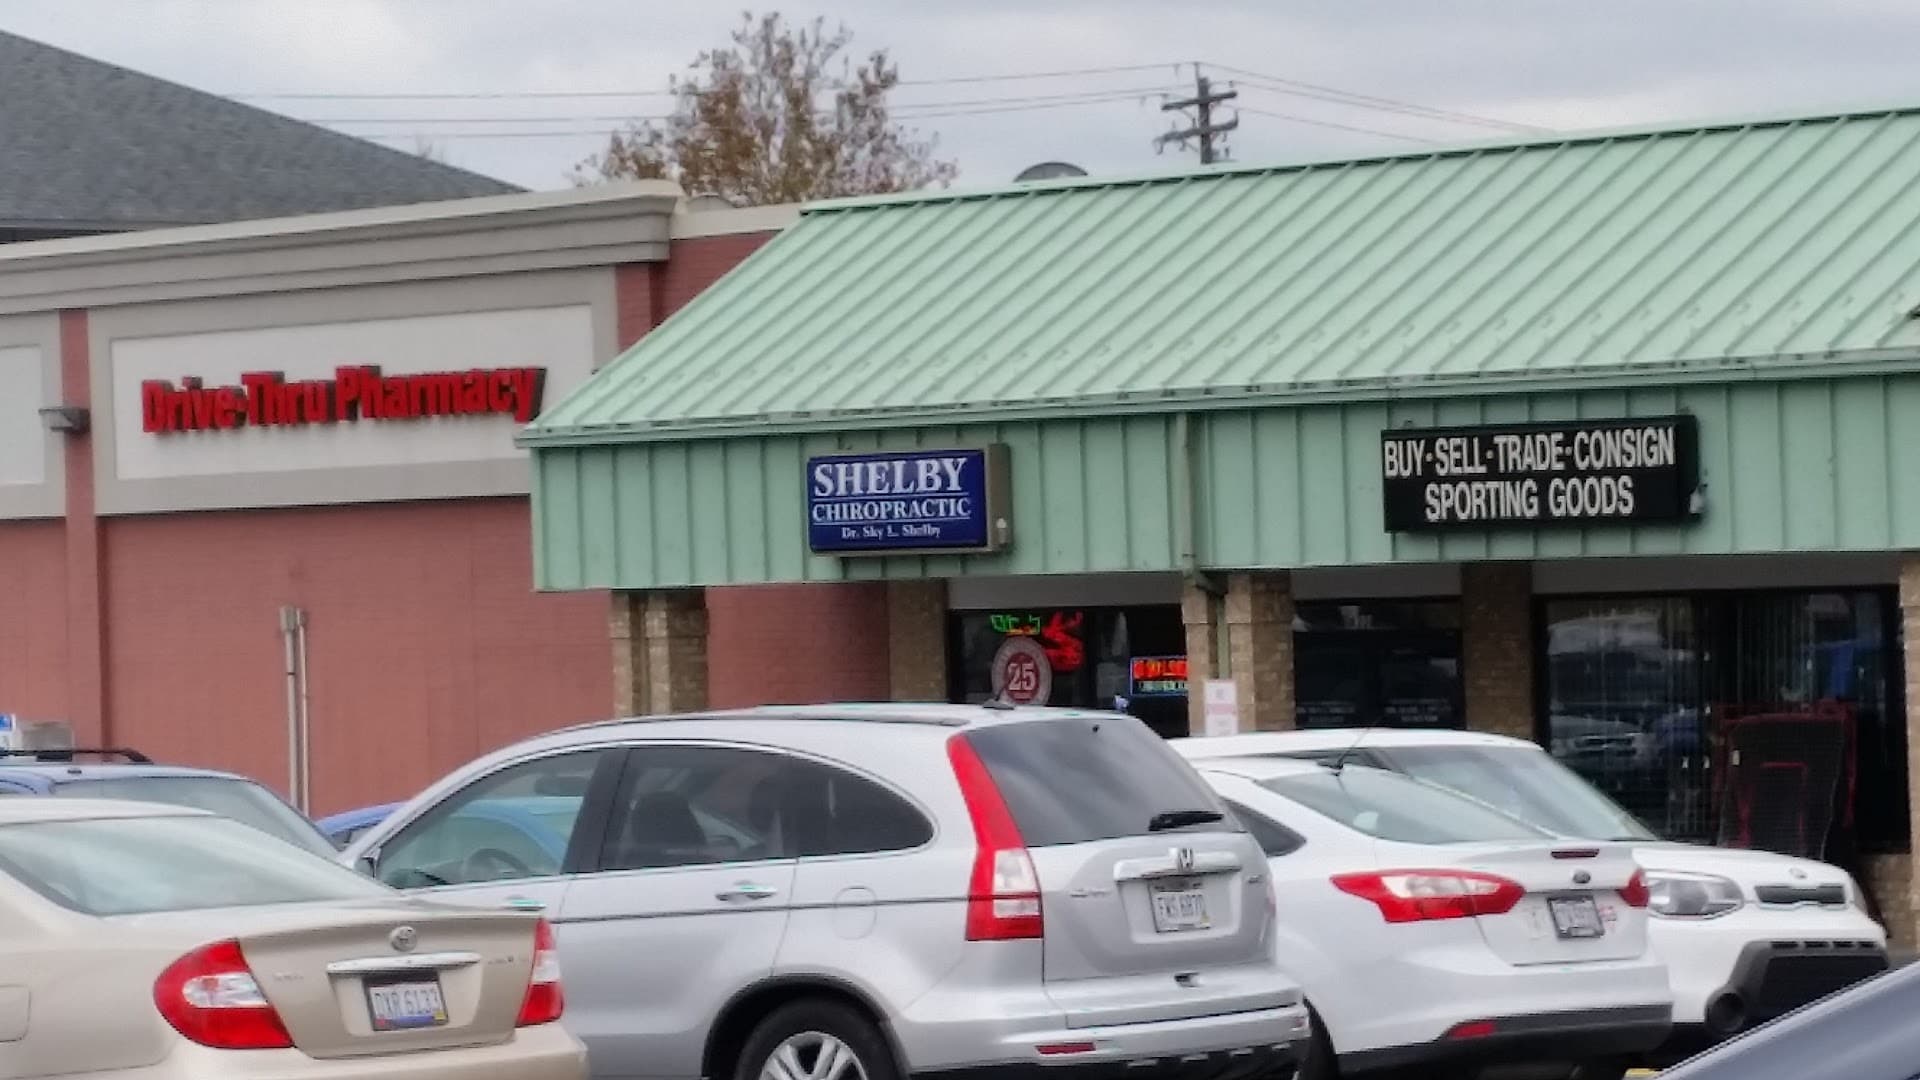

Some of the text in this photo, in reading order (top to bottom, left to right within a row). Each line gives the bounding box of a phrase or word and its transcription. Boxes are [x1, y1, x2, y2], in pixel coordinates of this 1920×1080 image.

[143, 365, 545, 432] Drive-Thru Pharmacy
[814, 458, 968, 496] SHELBY
[812, 498, 971, 522] CHIROPRACTIC
[1425, 475, 1634, 523] SPORTING GOODS
[841, 527, 860, 539] Dr.
[863, 525, 883, 540] Sky
[902, 524, 941, 538] Shelby
[1007, 663, 1036, 692] 25
